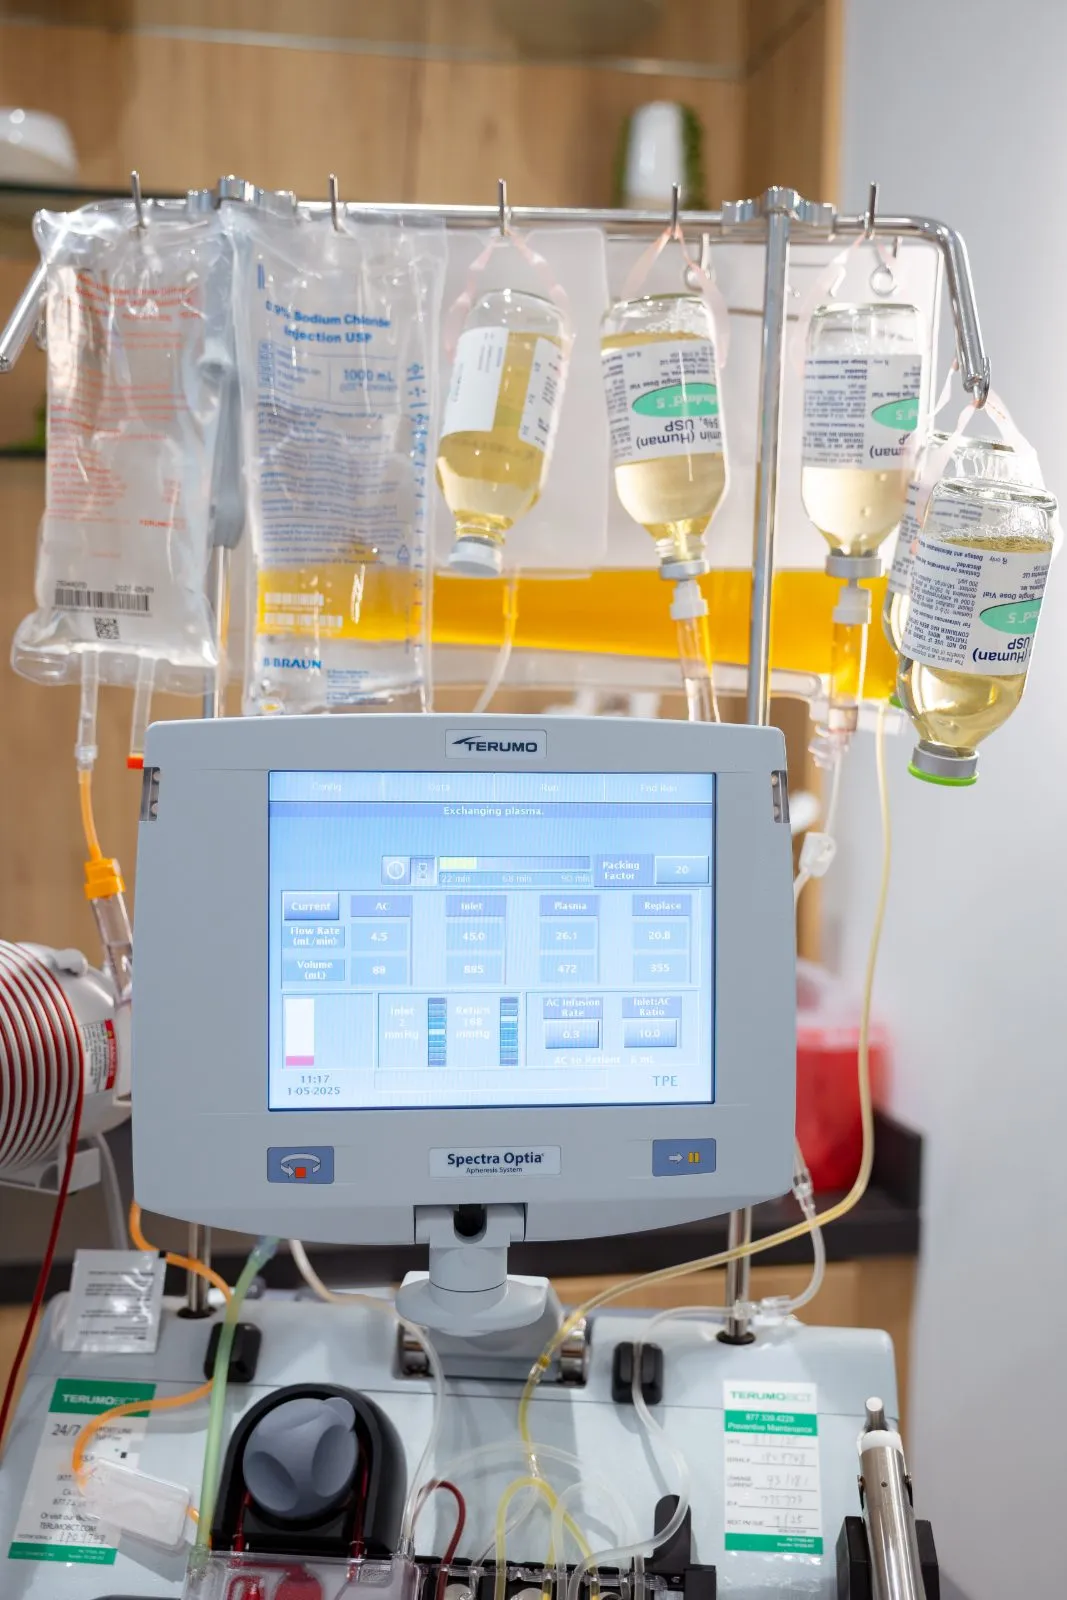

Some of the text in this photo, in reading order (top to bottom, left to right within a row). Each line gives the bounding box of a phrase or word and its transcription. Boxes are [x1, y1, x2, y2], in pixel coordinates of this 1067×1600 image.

[294, 311, 341, 325] Sodium
[284, 326, 372, 343] Injection USP
[344, 369, 374, 381] 1000
[664, 420, 694, 432] USP
[636, 431, 695, 449] (Human)
[870, 446, 904, 458] man)
[1000, 592, 1016, 600] Dose
[1007, 637, 1030, 650] USP
[972, 648, 1027, 663] (Human)
[273, 658, 322, 669] BRAUN
[464, 741, 538, 753] TERUMO
[443, 806, 544, 818] Exchanging plasma.
[602, 861, 640, 872] Packing
[674, 866, 690, 875] 20
[604, 872, 636, 881] Factor
[291, 902, 331, 911] Current
[375, 902, 390, 911] AC
[461, 902, 483, 911] Inlet
[554, 901, 587, 911] Plasma
[644, 901, 682, 912] Replace
[290, 927, 340, 936] Flow Rate
[555, 931, 577, 941] 26.1
[648, 931, 671, 941] 20.8
[370, 932, 388, 942] 4.5
[462, 932, 485, 942] 45.0
[297, 960, 333, 970] Volume
[557, 964, 577, 973] 472
[546, 997, 600, 1007] AC Infusion
[633, 997, 670, 1006] Inlet:AC
[390, 1006, 415, 1016] Inlet
[455, 1006, 490, 1015] Return
[562, 1009, 585, 1017] Rate
[639, 1007, 665, 1017] Ratio
[301, 1075, 330, 1083] 11:17
[652, 1075, 678, 1087] TPE
[447, 1151, 543, 1167] Spectra Optia
[499, 1166, 523, 1174] System
[52, 1423, 81, 1437] 24/7
[767, 1424, 813, 1433] Maintenance
